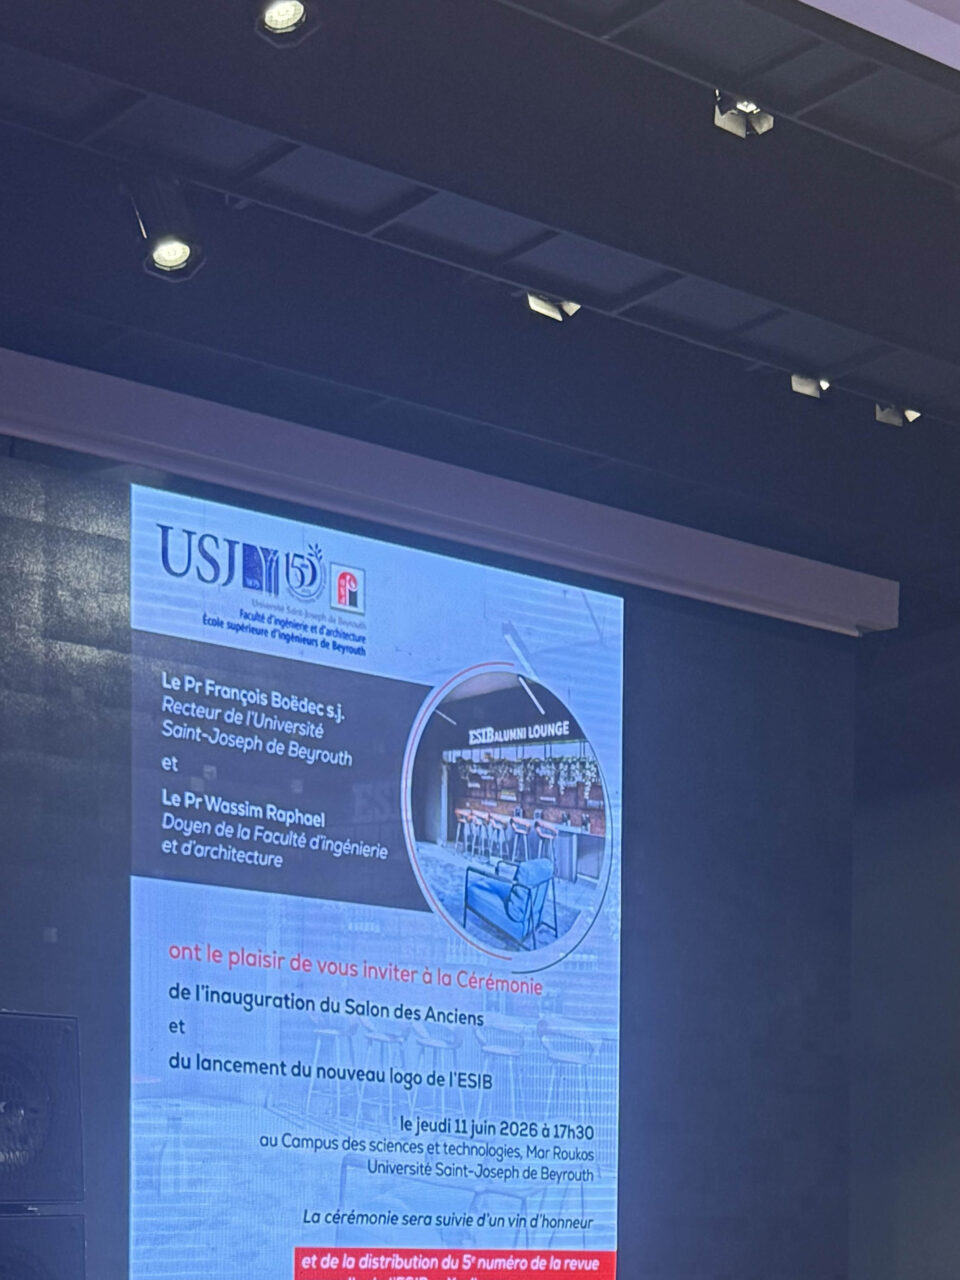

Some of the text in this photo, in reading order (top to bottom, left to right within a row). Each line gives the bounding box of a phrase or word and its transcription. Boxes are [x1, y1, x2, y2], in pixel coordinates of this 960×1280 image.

[156, 523, 239, 587] USJ
[240, 608, 265, 623] Faculté
[203, 613, 366, 657] École supérieure d'ingénieurs de Beyrouth
[161, 671, 345, 724] Le Pr François Boëdec s.j.
[162, 695, 324, 739] Recteur de l'Université
[528, 720, 570, 739] LOUNGE
[162, 720, 353, 766] Saint-Joseph de Beyrouth
[161, 756, 178, 772] et
[161, 789, 326, 828] Le Pr Wassim Raphael
[162, 812, 389, 860] Doyen de la Faculté d'ingénierie
[161, 839, 284, 868] et d'architecture
[168, 944, 543, 995] ont le plaisir de vous inviter à la Cérémonie
[169, 982, 484, 1027] de l'inauguration du Salon des Anciens
[169, 1018, 186, 1034] et
[169, 1052, 493, 1091] du lancement du nouveau logo de l'ESIB
[400, 1115, 594, 1140] le jeudi 11 juin 2026 à 17h30
[260, 1132, 595, 1162] au Campus des sciences et technologies, Mar Roukos
[367, 1159, 594, 1184] Université Saint-Joseph de Beyrouth
[303, 1208, 594, 1230] La cérémonie sera suivie d'un vin d'honneur
[301, 1255, 318, 1270] et
[320, 1253, 339, 1270] de
[342, 1253, 355, 1270] la
[358, 1253, 439, 1270] distribution
[441, 1254, 459, 1270] du
[477, 1254, 528, 1270] numéro
[530, 1255, 547, 1270] de
[550, 1255, 561, 1270] la
[563, 1258, 600, 1271] revue
